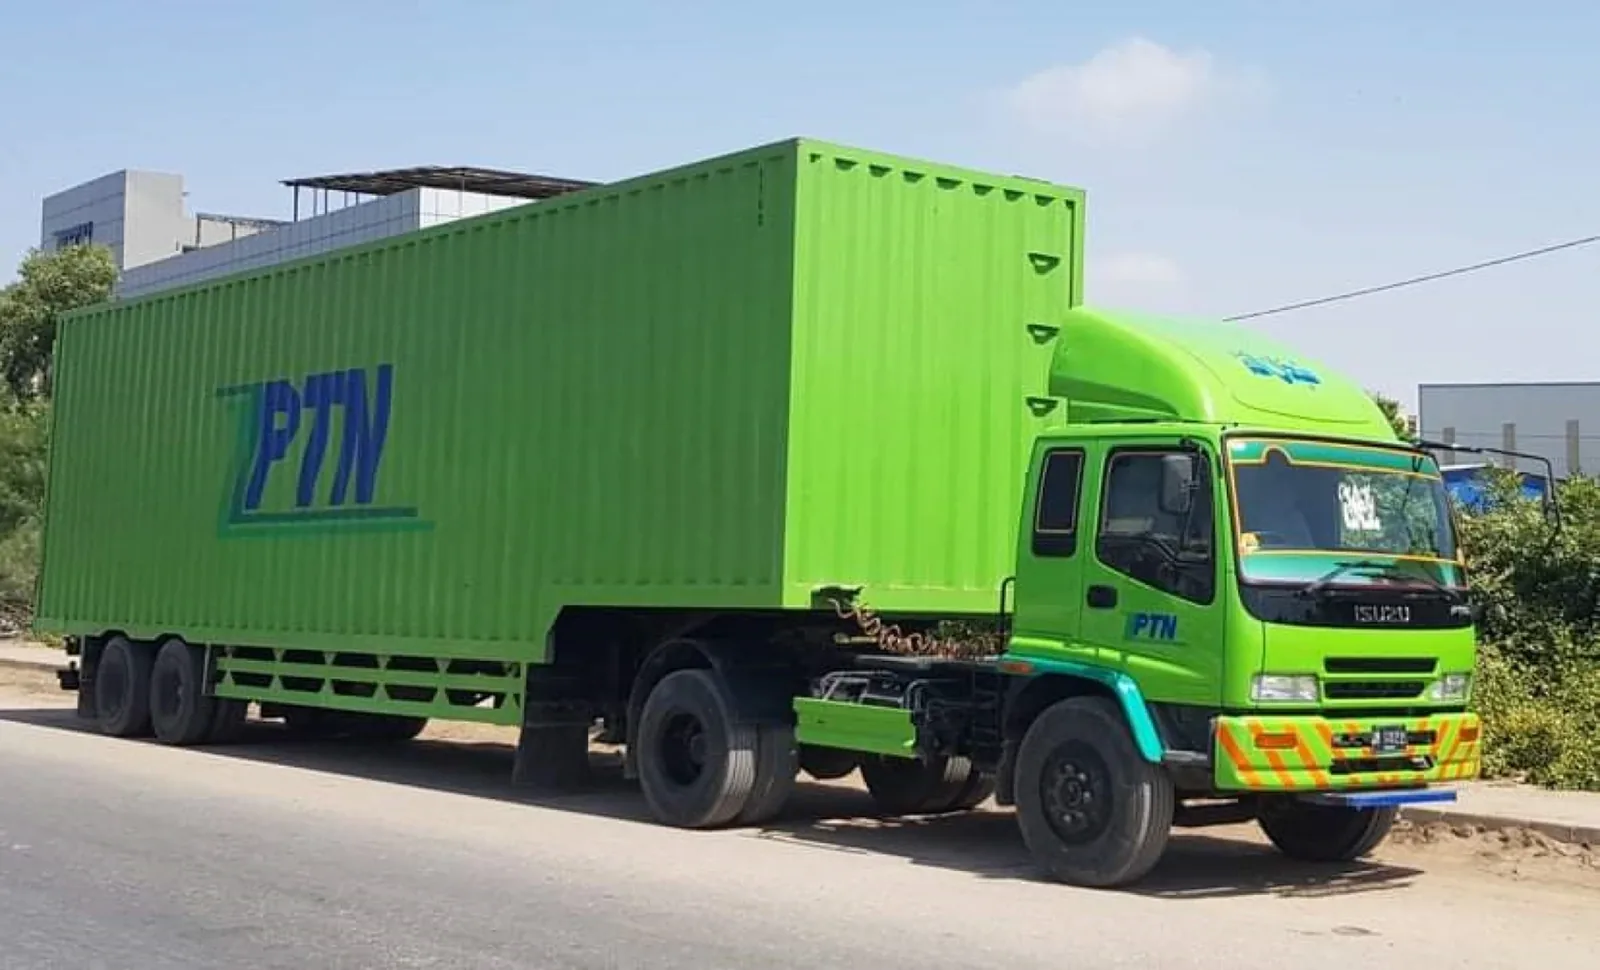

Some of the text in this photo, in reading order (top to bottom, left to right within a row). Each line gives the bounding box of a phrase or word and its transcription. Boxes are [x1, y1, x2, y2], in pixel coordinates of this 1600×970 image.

[245, 364, 393, 509] PTN
[1133, 613, 1177, 639] PTN
[1354, 605, 1409, 622] ISUZU
